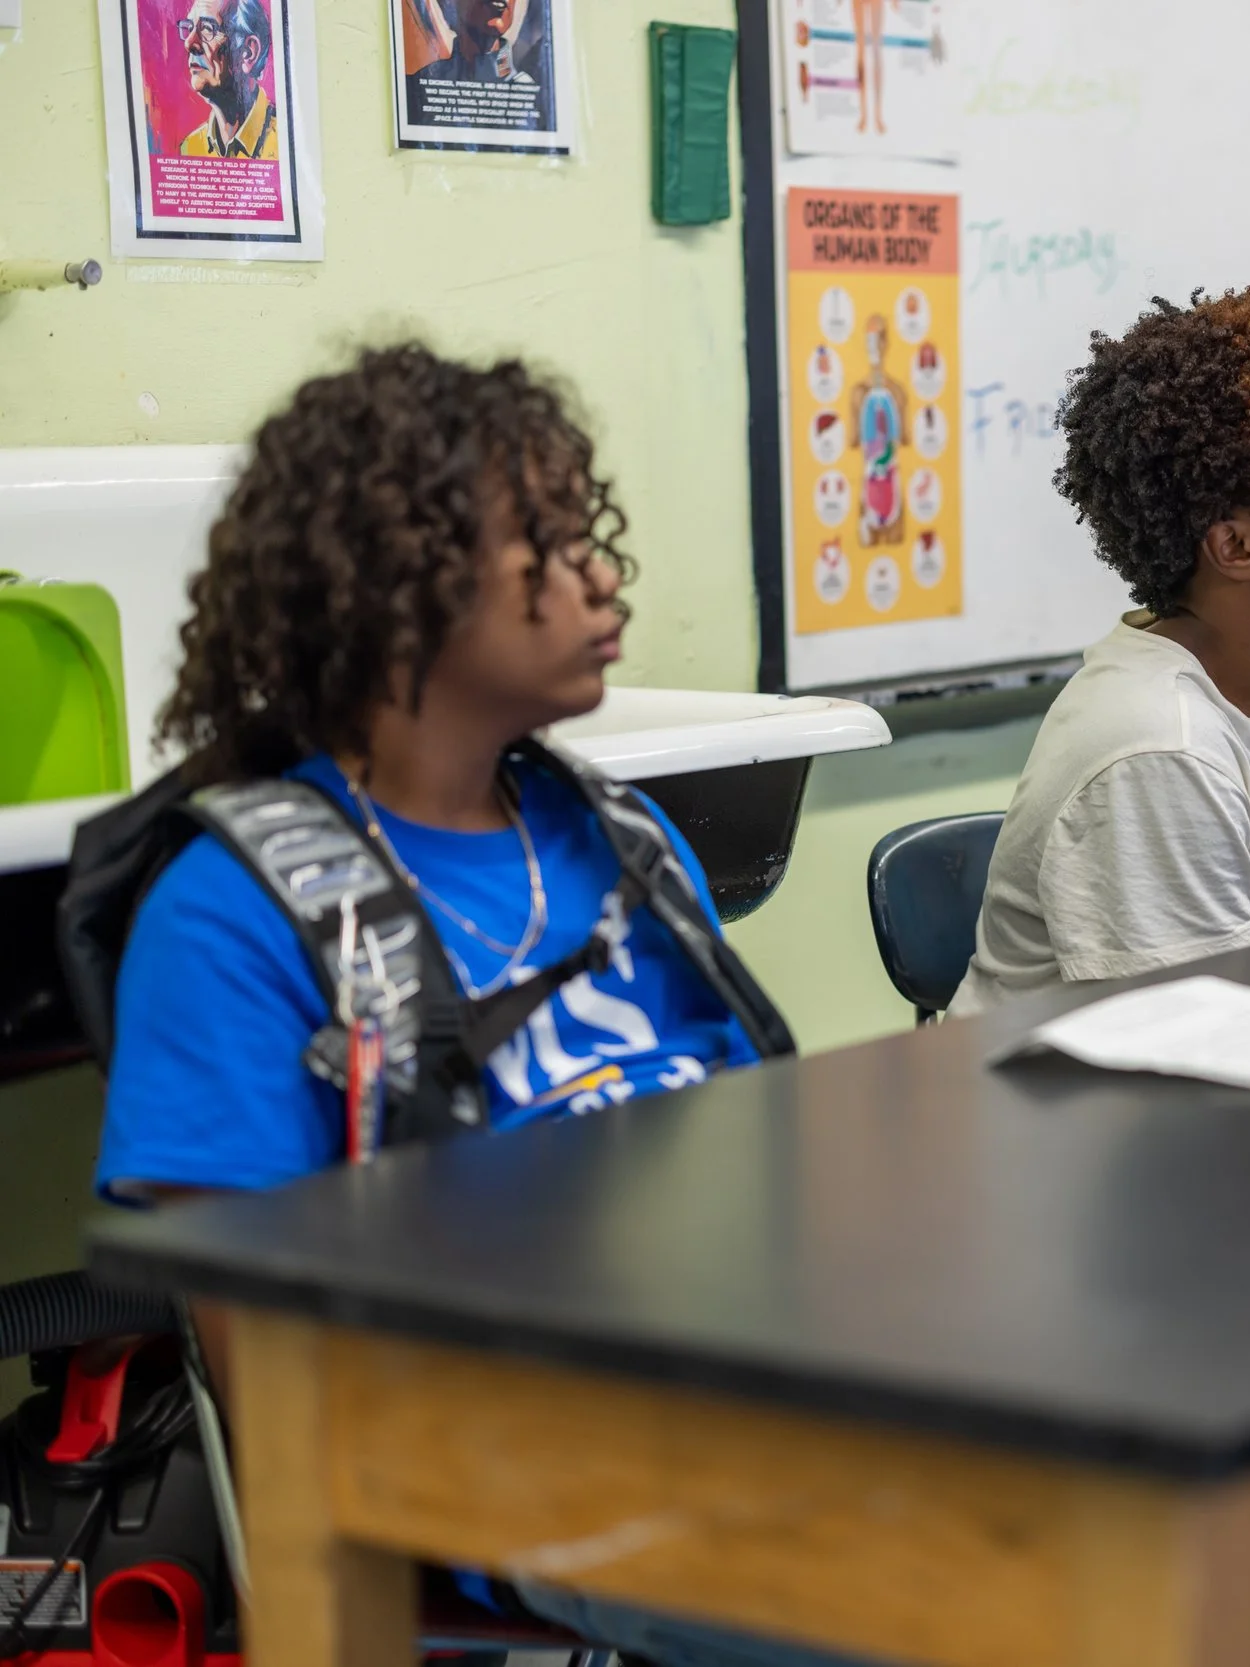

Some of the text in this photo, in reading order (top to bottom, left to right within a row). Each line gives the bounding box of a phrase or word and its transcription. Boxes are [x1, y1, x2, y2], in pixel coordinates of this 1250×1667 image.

[422, 105, 444, 113] SERVED
[803, 200, 941, 234] ORGANS OF THE
[812, 233, 933, 266] HUMAN BODY
